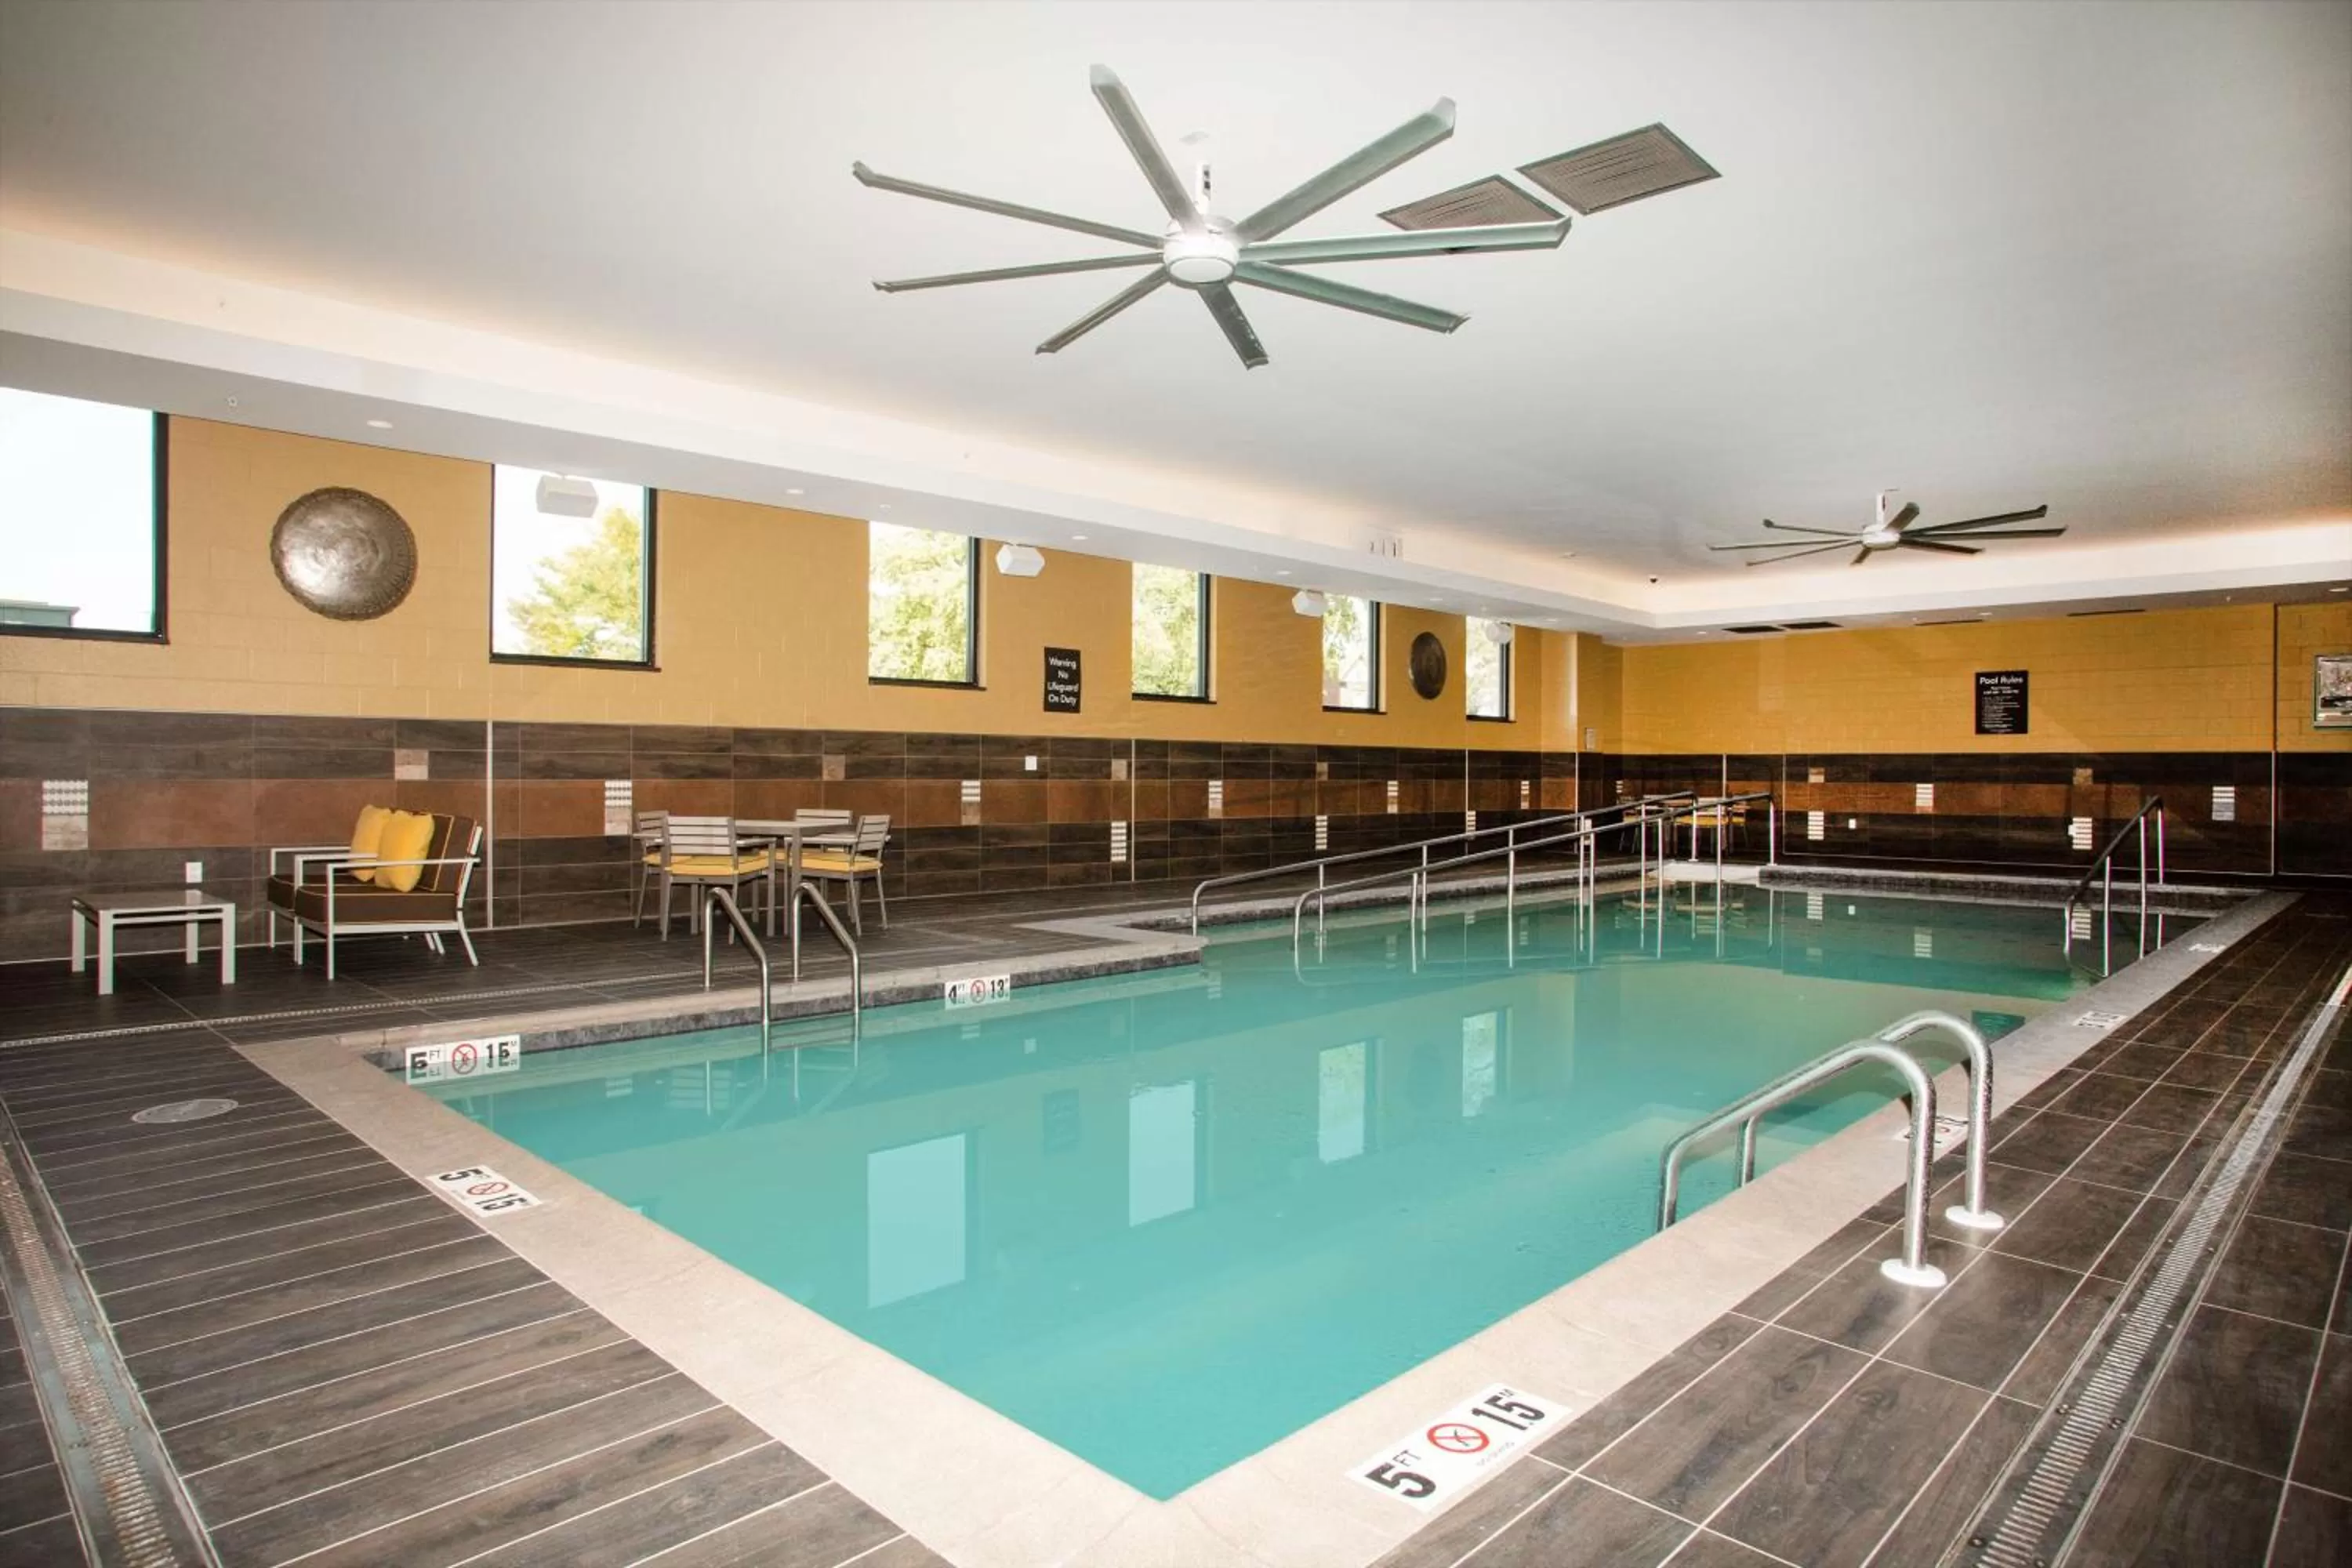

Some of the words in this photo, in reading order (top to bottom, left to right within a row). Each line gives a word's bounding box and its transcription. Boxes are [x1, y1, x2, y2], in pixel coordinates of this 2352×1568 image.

[1048, 655, 1076, 670] Warning
[1058, 670, 1069, 680] No
[1047, 681, 1079, 693] Lifeguard
[1048, 693, 1059, 703] On
[1060, 695, 1077, 706] Duty
[439, 1168, 484, 1181] 5
[1392, 1449, 1421, 1467] FT
[1365, 1462, 1436, 1498] 5
